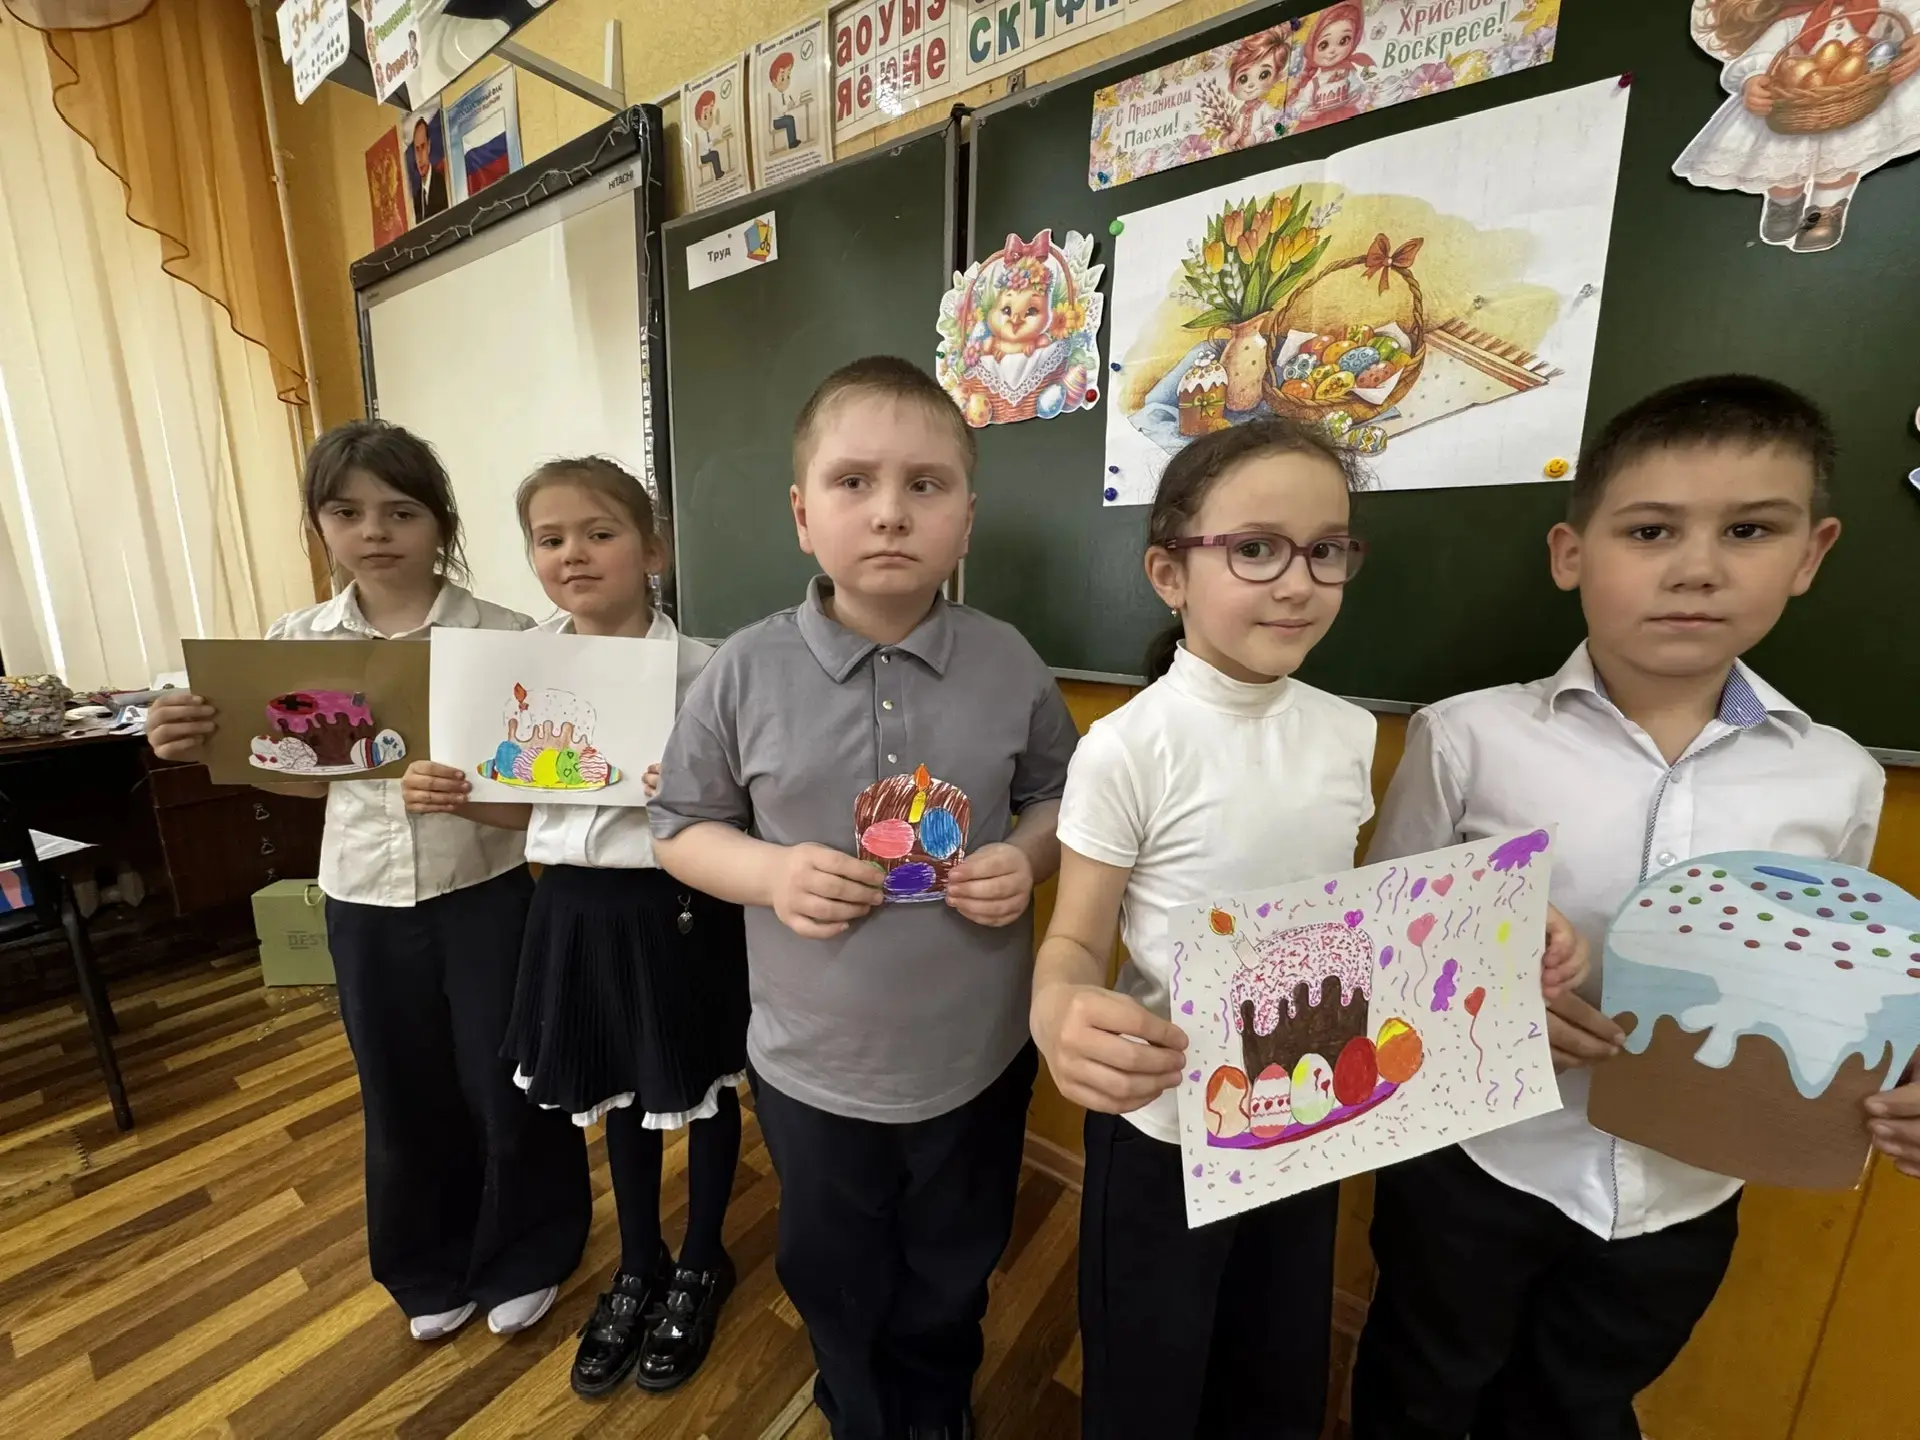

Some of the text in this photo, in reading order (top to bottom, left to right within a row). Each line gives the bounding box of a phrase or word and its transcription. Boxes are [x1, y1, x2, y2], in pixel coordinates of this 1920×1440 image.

[1382, 1, 1507, 69] Воскресе!
[1397, 0, 1494, 36] Христо
[1116, 90, 1193, 127] С Праздником
[1124, 111, 1180, 149] Пасхи!
[608, 169, 634, 190] HITACHI
[707, 246, 732, 263] Труд
